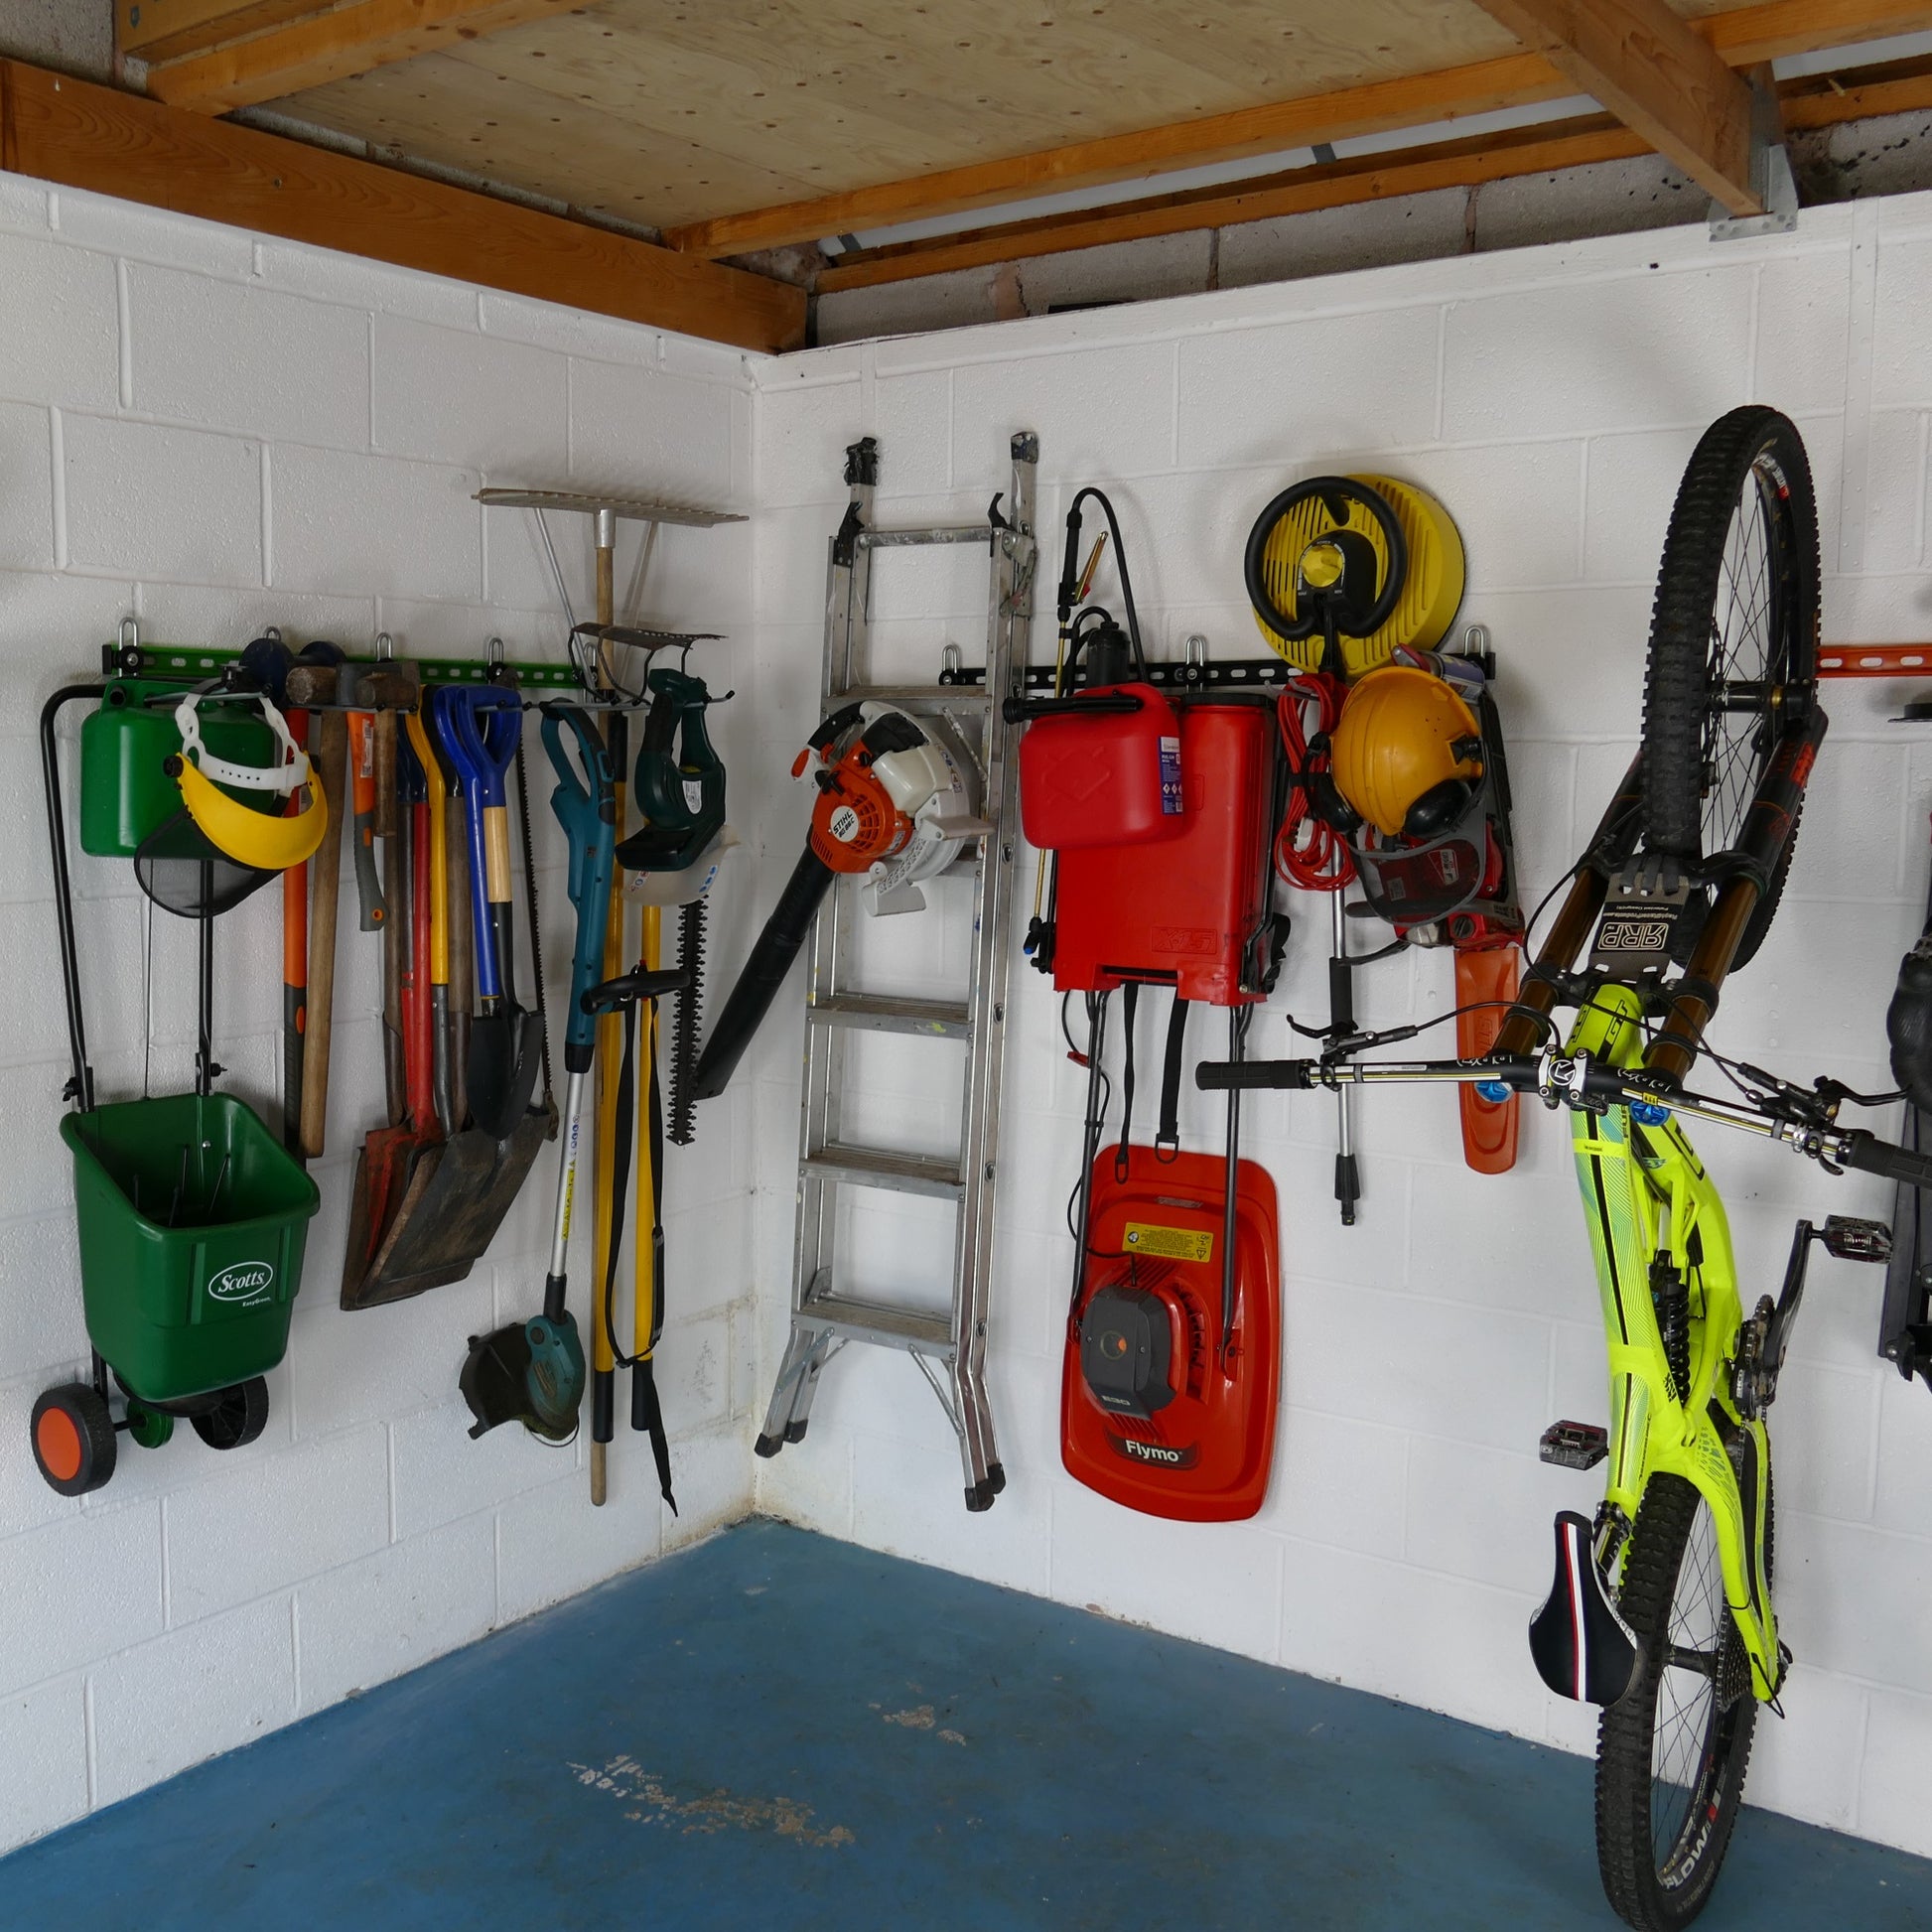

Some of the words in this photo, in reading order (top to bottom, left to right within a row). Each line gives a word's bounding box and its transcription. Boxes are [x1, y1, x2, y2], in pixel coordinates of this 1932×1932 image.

[833, 811, 852, 834] STIHL
[217, 1271, 265, 1294] Scotts
[1125, 1439, 1179, 1462] Flymo
